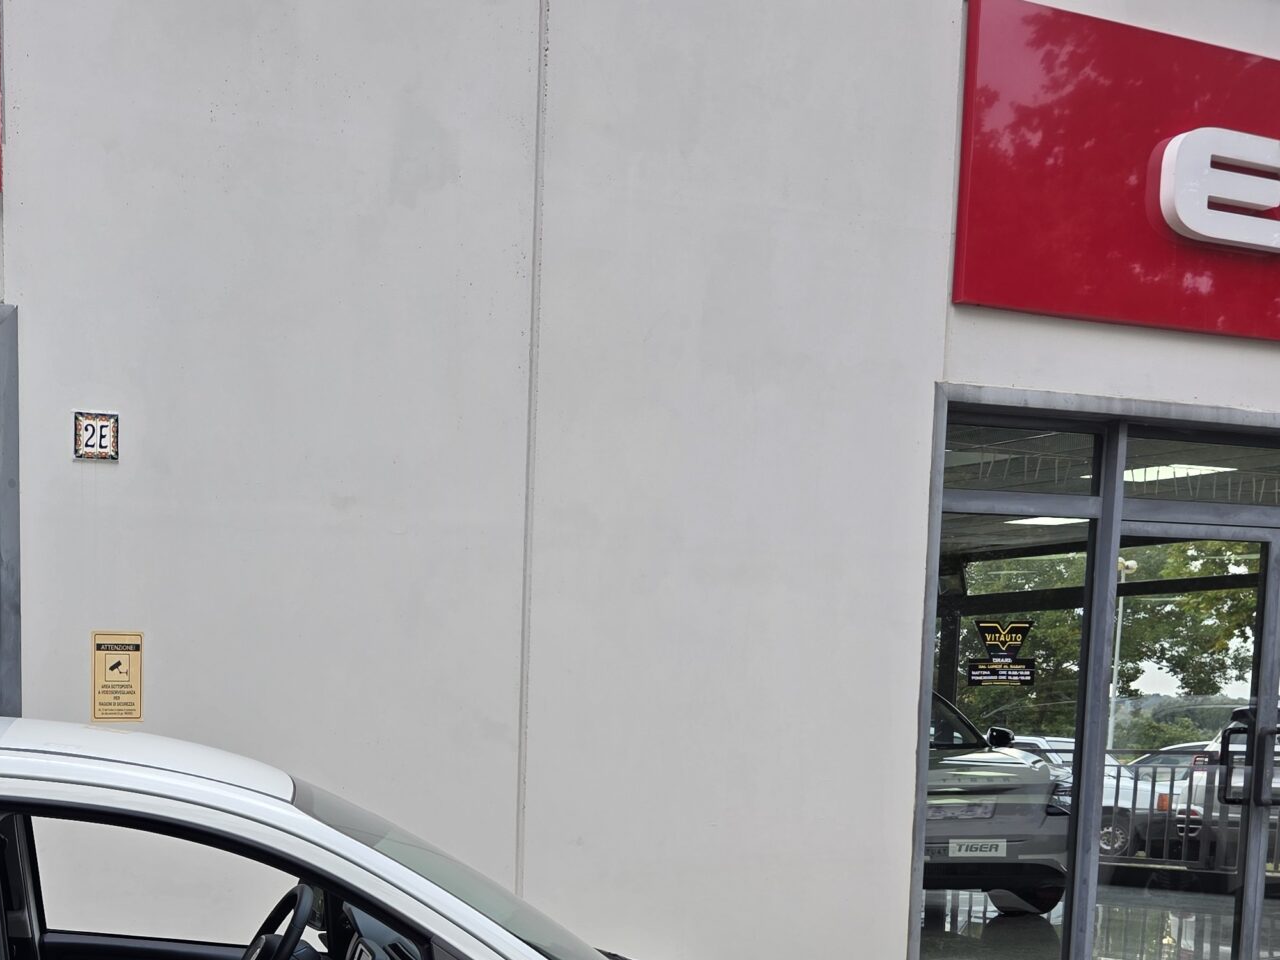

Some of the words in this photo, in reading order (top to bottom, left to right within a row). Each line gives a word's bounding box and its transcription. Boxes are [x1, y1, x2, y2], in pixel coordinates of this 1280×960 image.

[84, 424, 109, 449] 2E
[985, 633, 1022, 641] VITAUTO
[955, 843, 999, 852] TIGER
